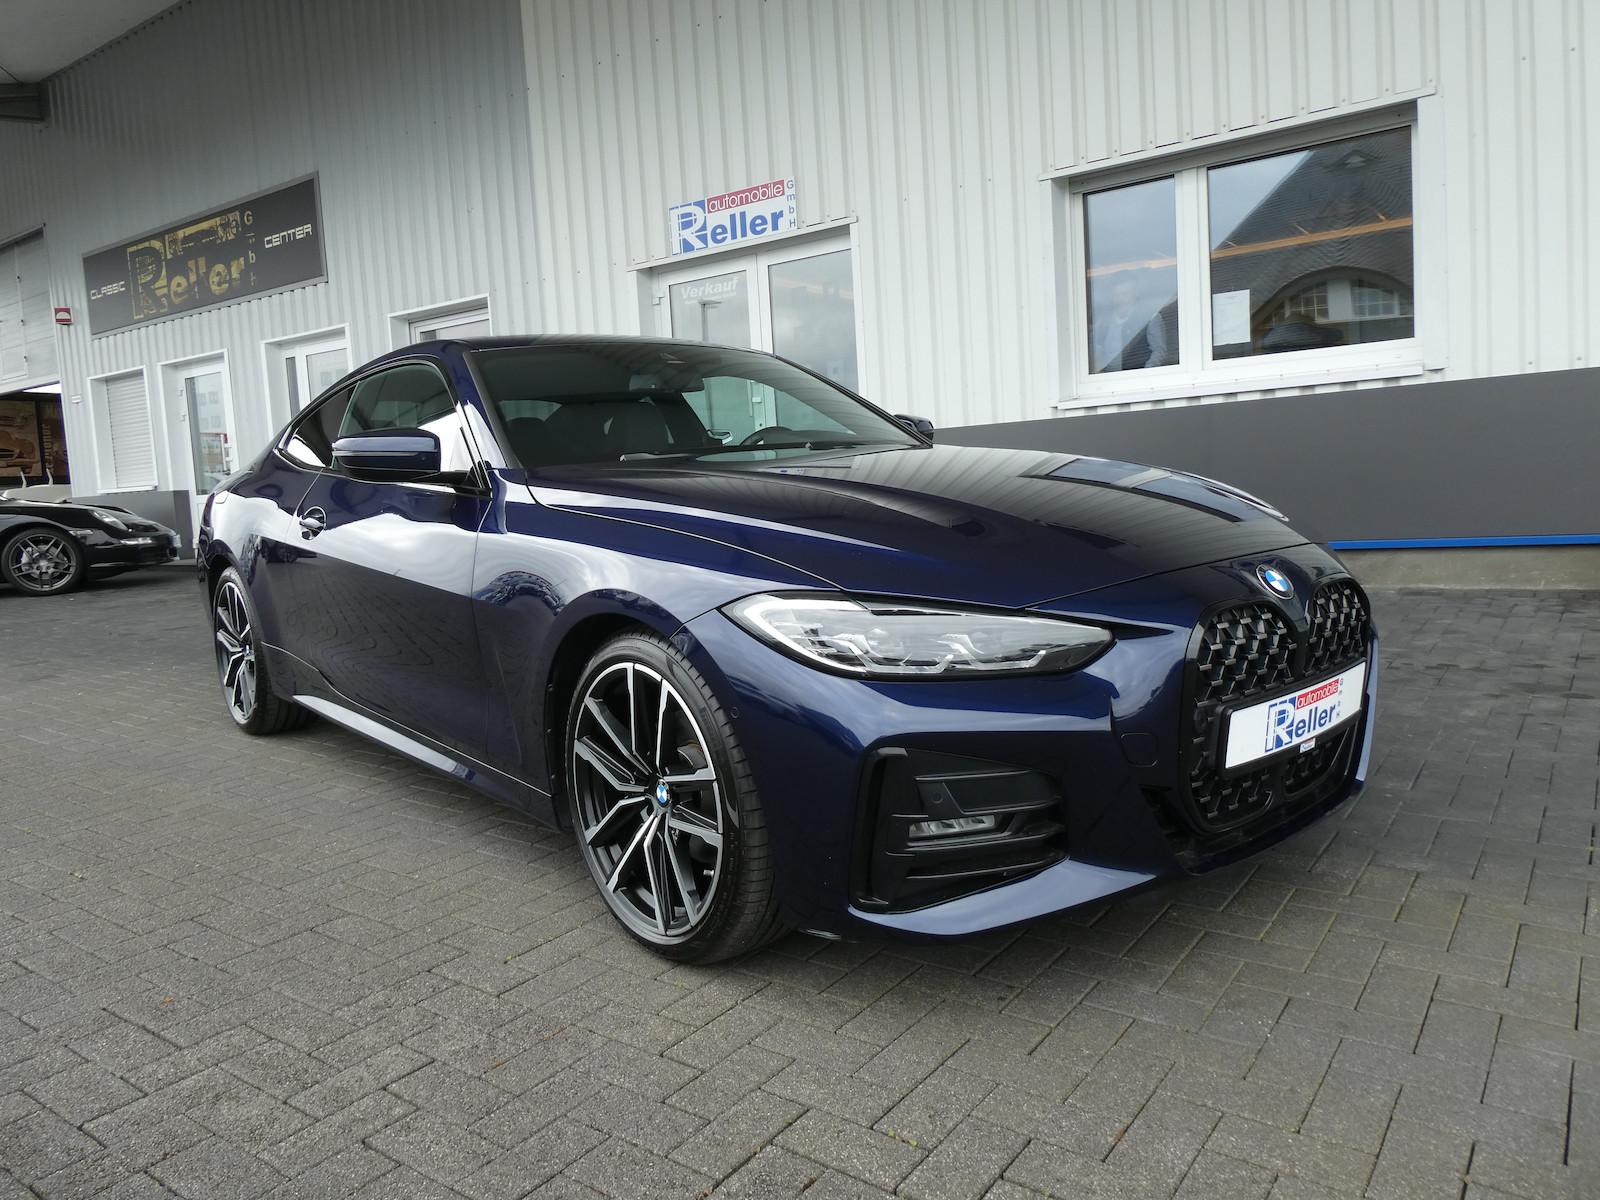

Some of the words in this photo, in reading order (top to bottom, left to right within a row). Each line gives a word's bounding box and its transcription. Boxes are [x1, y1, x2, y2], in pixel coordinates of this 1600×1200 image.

[708, 182, 784, 213] automobile
[264, 223, 313, 249] CENTER
[669, 199, 784, 256] Reller
[681, 277, 739, 300] Verkauf
[1297, 681, 1339, 709] automobile
[1265, 697, 1336, 753] Reller
